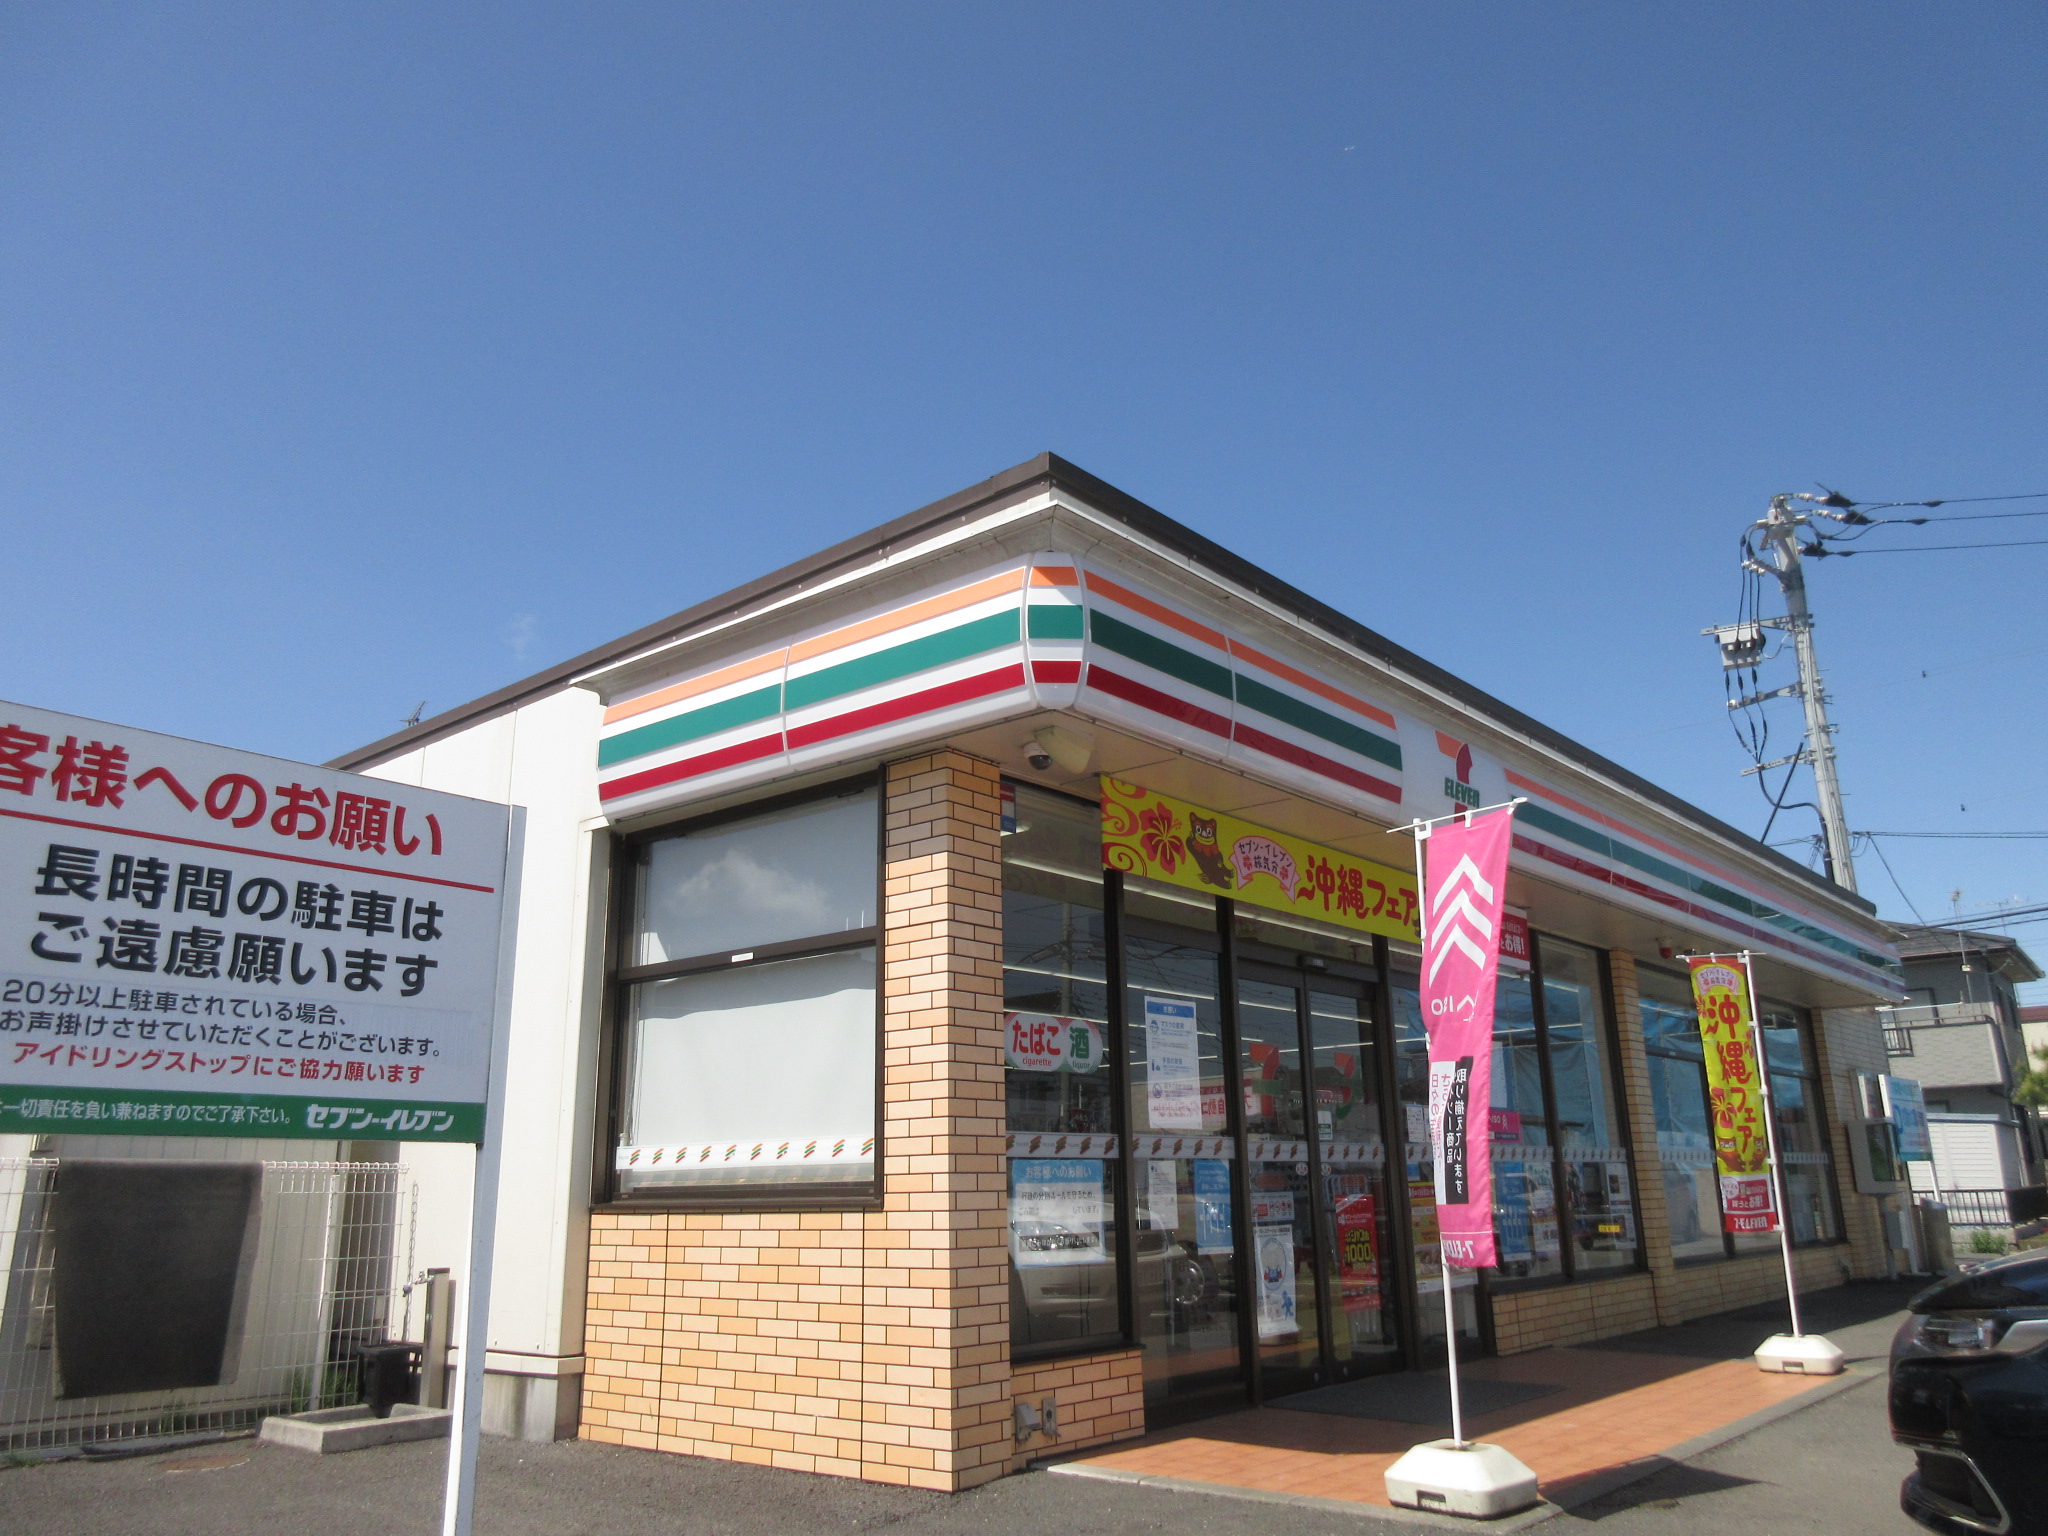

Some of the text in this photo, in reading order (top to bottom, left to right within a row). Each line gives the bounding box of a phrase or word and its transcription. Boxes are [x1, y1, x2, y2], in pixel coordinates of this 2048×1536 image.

[0, 724, 443, 856] 客様へのお願い
[34, 843, 445, 943] 長時間の駐車は
[1297, 854, 1418, 926] 沖縄フェア
[30, 910, 439, 997] ご遠慮願います
[3, 978, 345, 1026] 20分以上駐車されている場合、
[0, 1009, 440, 1058] お声掛けさせていただくことがございます。
[1012, 1019, 1061, 1056] たばこ
[1069, 1026, 1090, 1059] 酒
[14, 1041, 425, 1084] アイドリングストップにご協力願います
[1022, 1057, 1052, 1067] cigarette
[1072, 1060, 1091, 1071] liquor
[1705, 994, 1757, 1153] 沖縄フェア
[1025, 1165, 1092, 1179] お客様へのお願い
